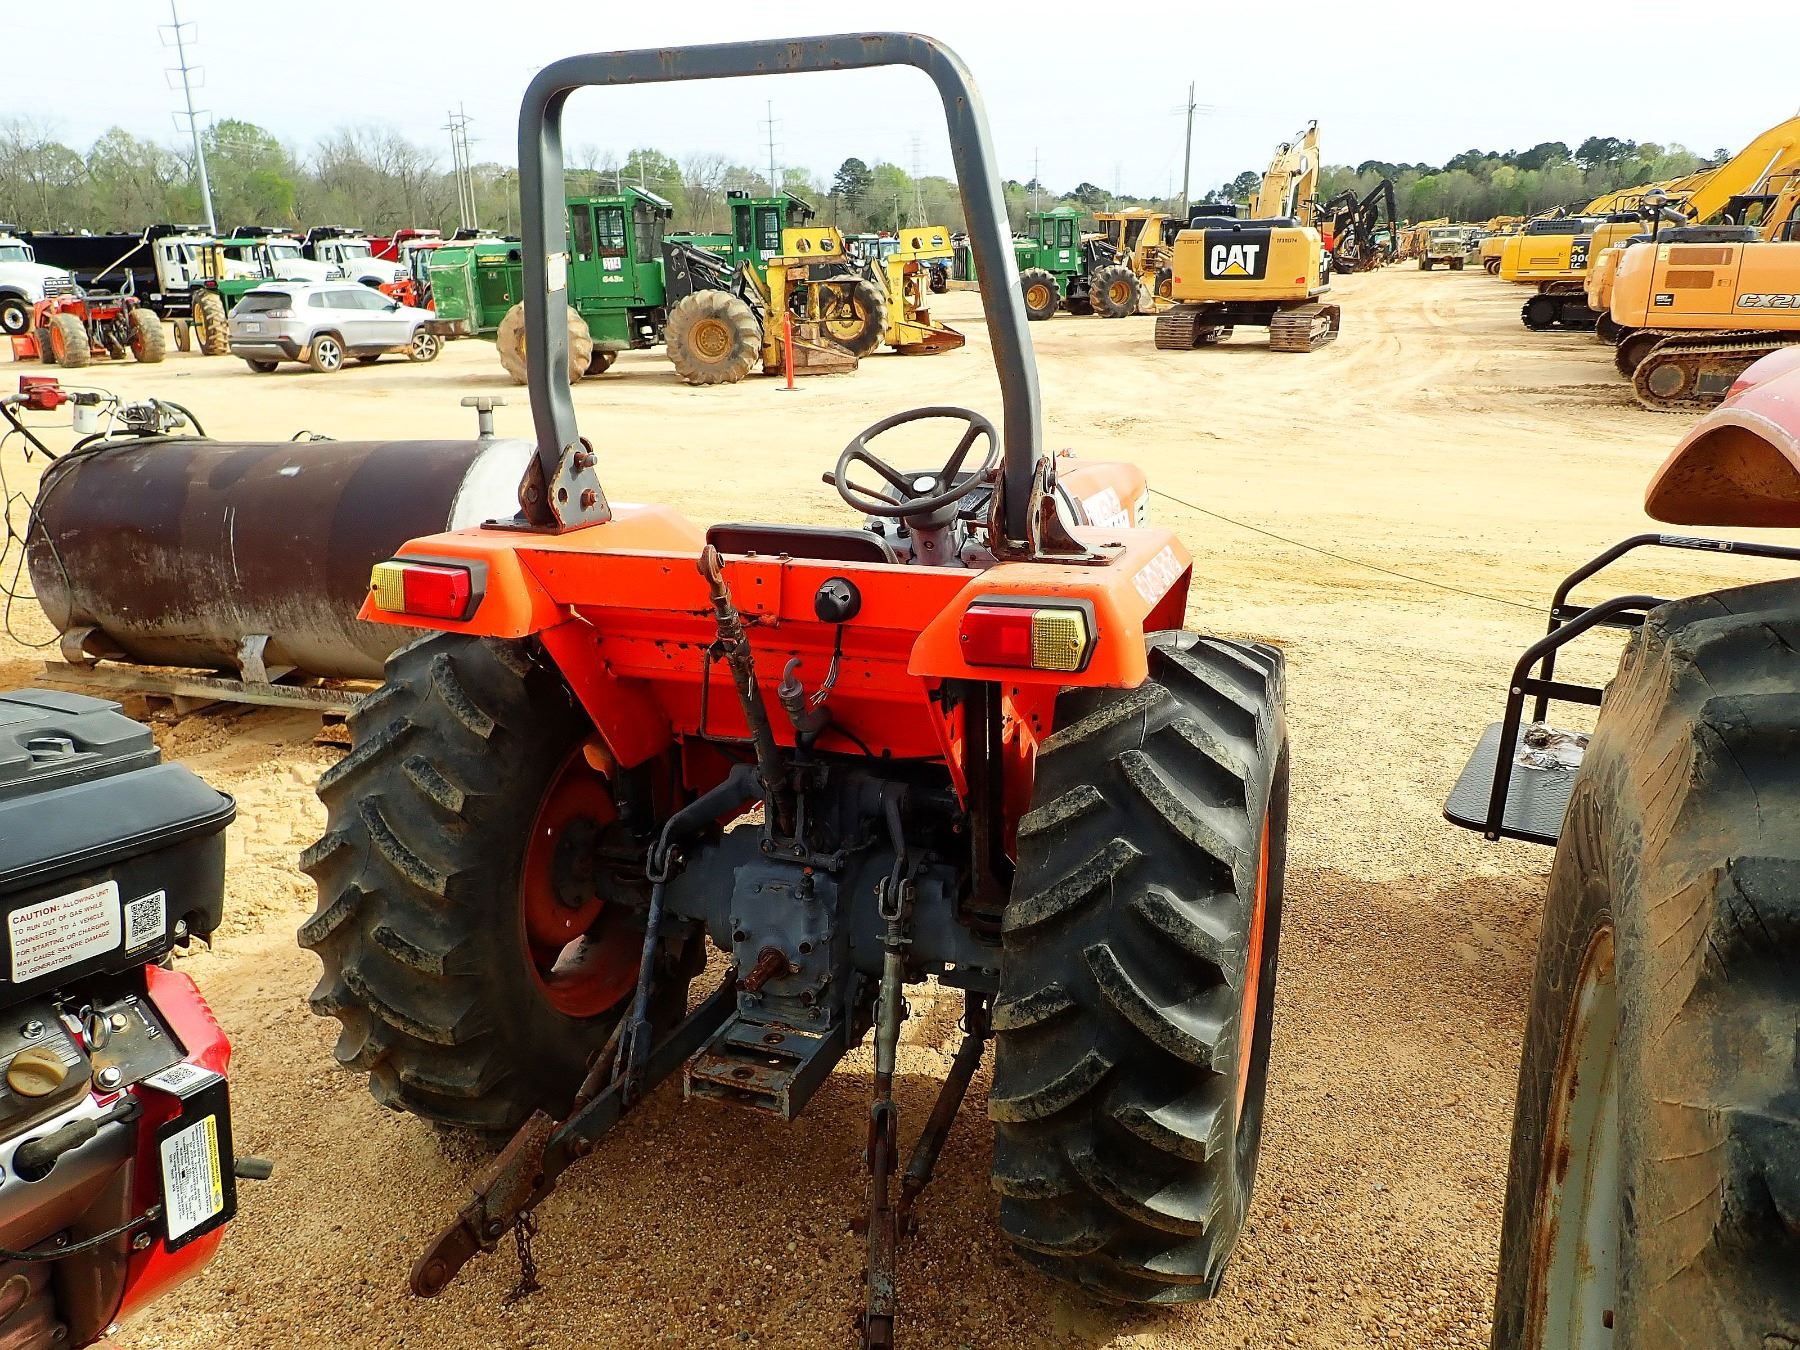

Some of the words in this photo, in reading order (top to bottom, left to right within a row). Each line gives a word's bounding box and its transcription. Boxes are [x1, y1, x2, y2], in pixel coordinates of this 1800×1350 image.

[1210, 245, 1259, 275] CAT
[13, 905, 60, 924] CAUTION:
[62, 894, 95, 909] ALLOWING
[96, 888, 109, 898] UNIT
[27, 923, 41, 932] RUN
[43, 918, 56, 927] OUT
[59, 914, 67, 922] OF
[69, 908, 82, 918] GAS
[84, 902, 103, 913] WHILE
[15, 929, 57, 947] CONNECTED
[80, 912, 104, 925] VEHICLE
[16, 949, 30, 958] FOR
[32, 937, 64, 952] STARTING
[67, 932, 76, 940] OR
[78, 921, 110, 936] CHARGING
[17, 960, 32, 968] MAY
[33, 950, 55, 962] CAUSE
[57, 940, 83, 954] SEVERE
[84, 930, 110, 944] DAMAGE
